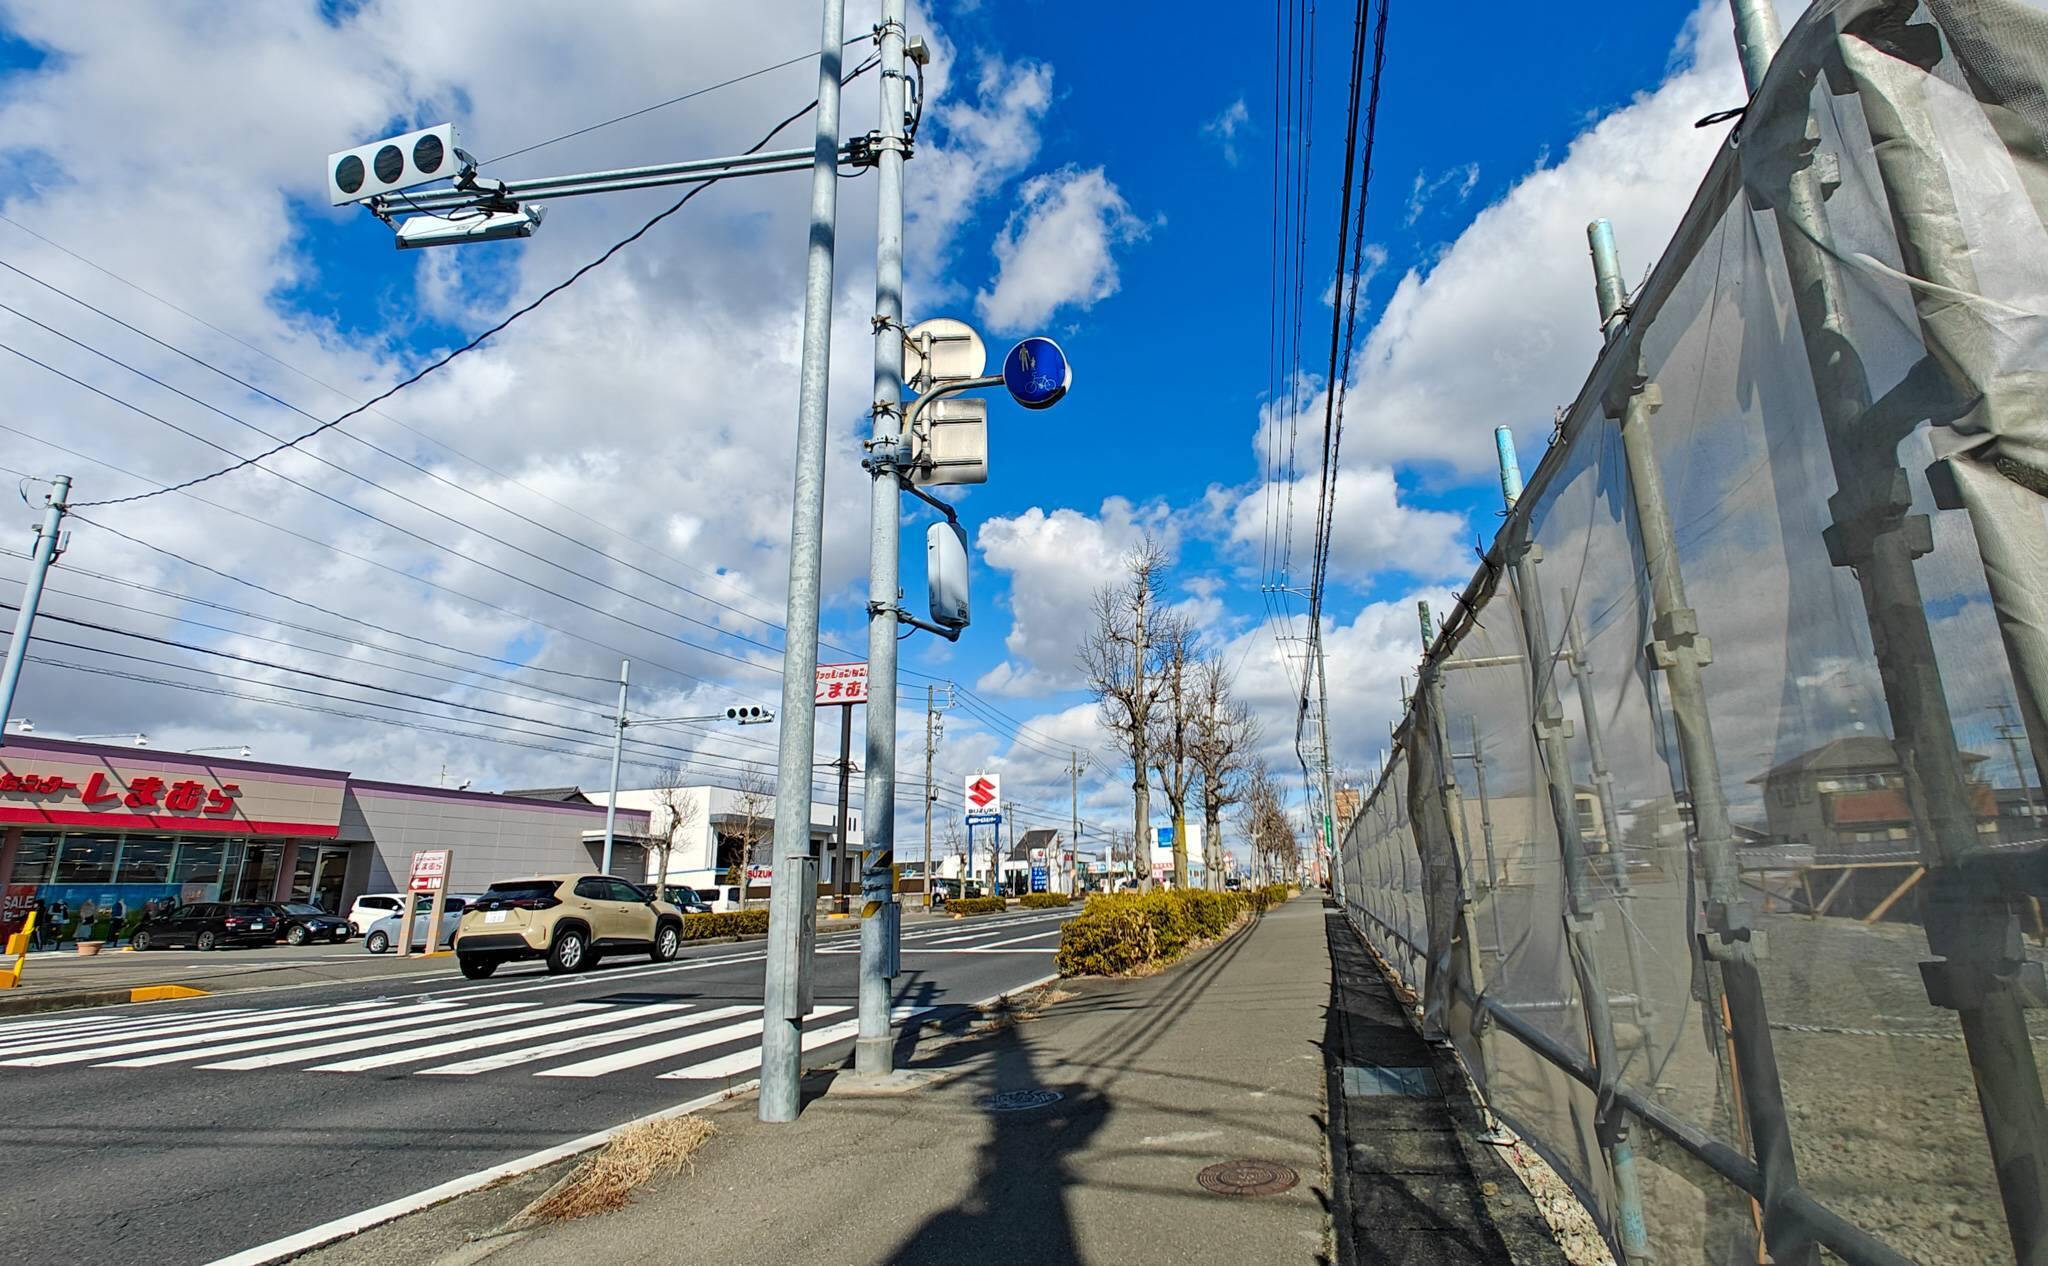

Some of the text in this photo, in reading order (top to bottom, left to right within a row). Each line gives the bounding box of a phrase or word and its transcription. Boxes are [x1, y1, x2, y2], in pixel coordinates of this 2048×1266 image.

[82, 773, 240, 814] しまむら
[428, 878, 442, 889] IN
